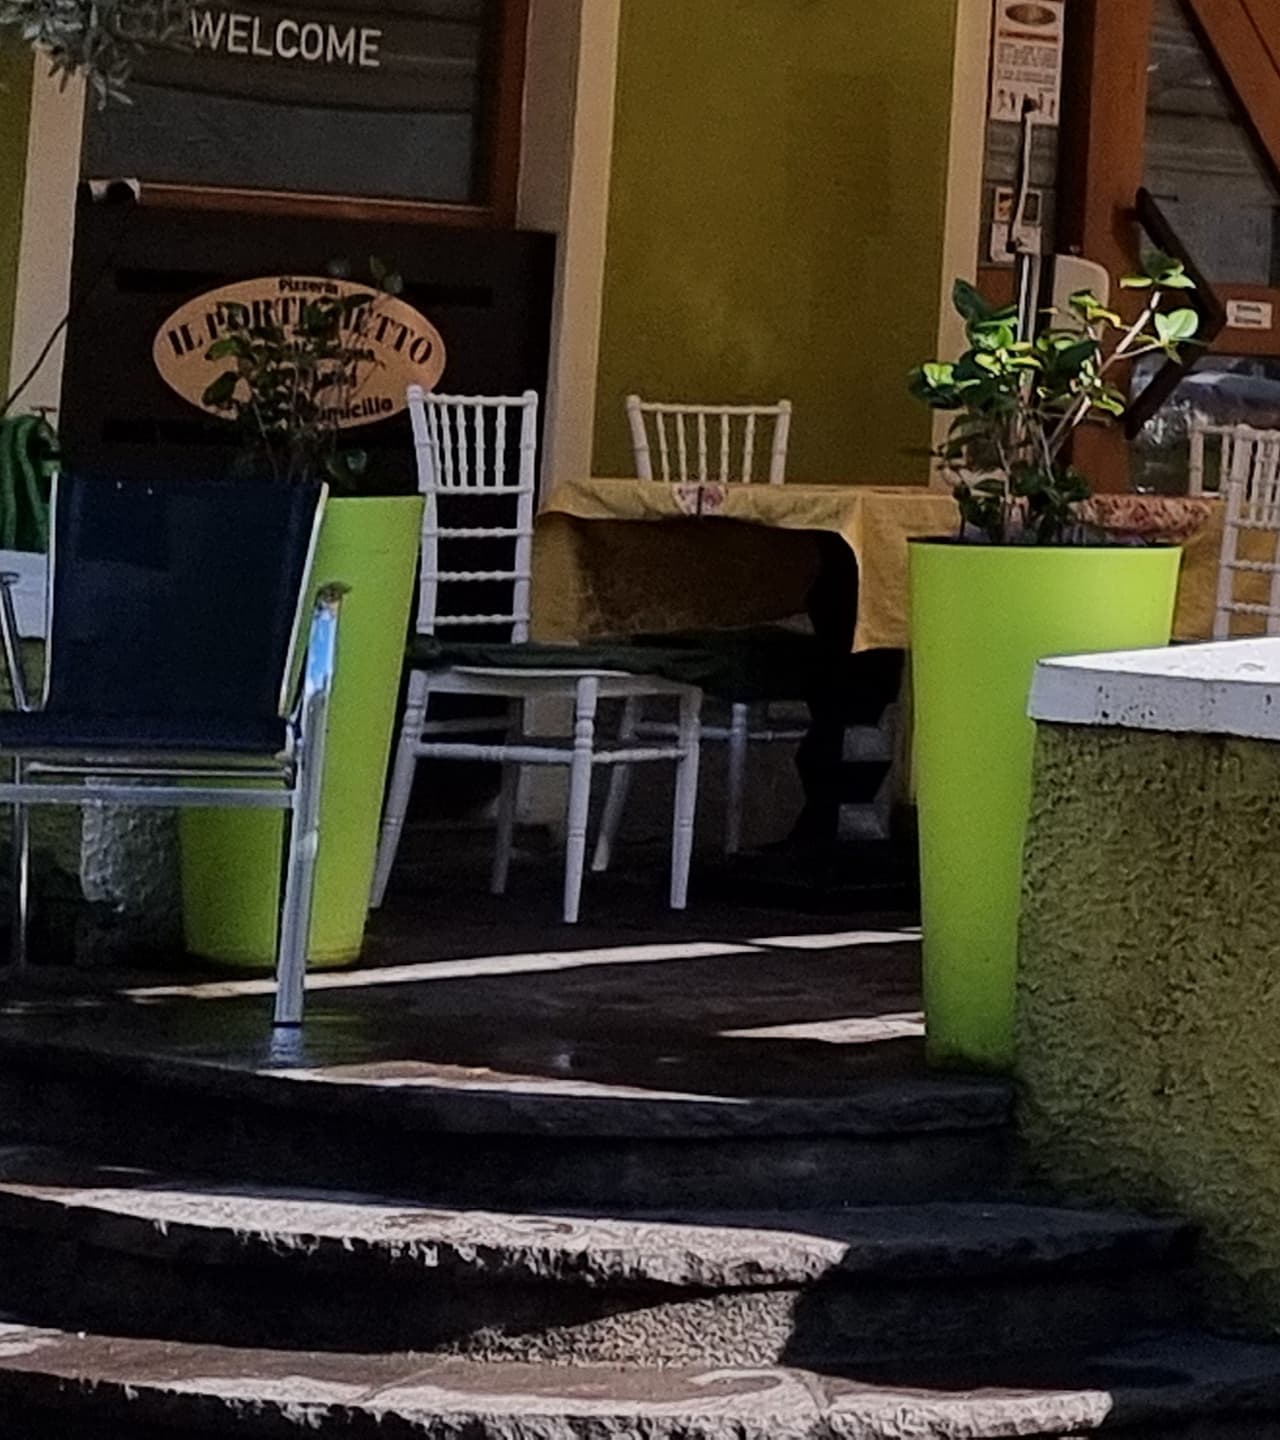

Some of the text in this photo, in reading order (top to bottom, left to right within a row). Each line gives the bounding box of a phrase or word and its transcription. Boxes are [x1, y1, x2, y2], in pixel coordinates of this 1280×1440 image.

[189, 8, 383, 68] WELCOME
[278, 278, 340, 296] Pizzeria
[205, 295, 433, 365] PORTIETTO
